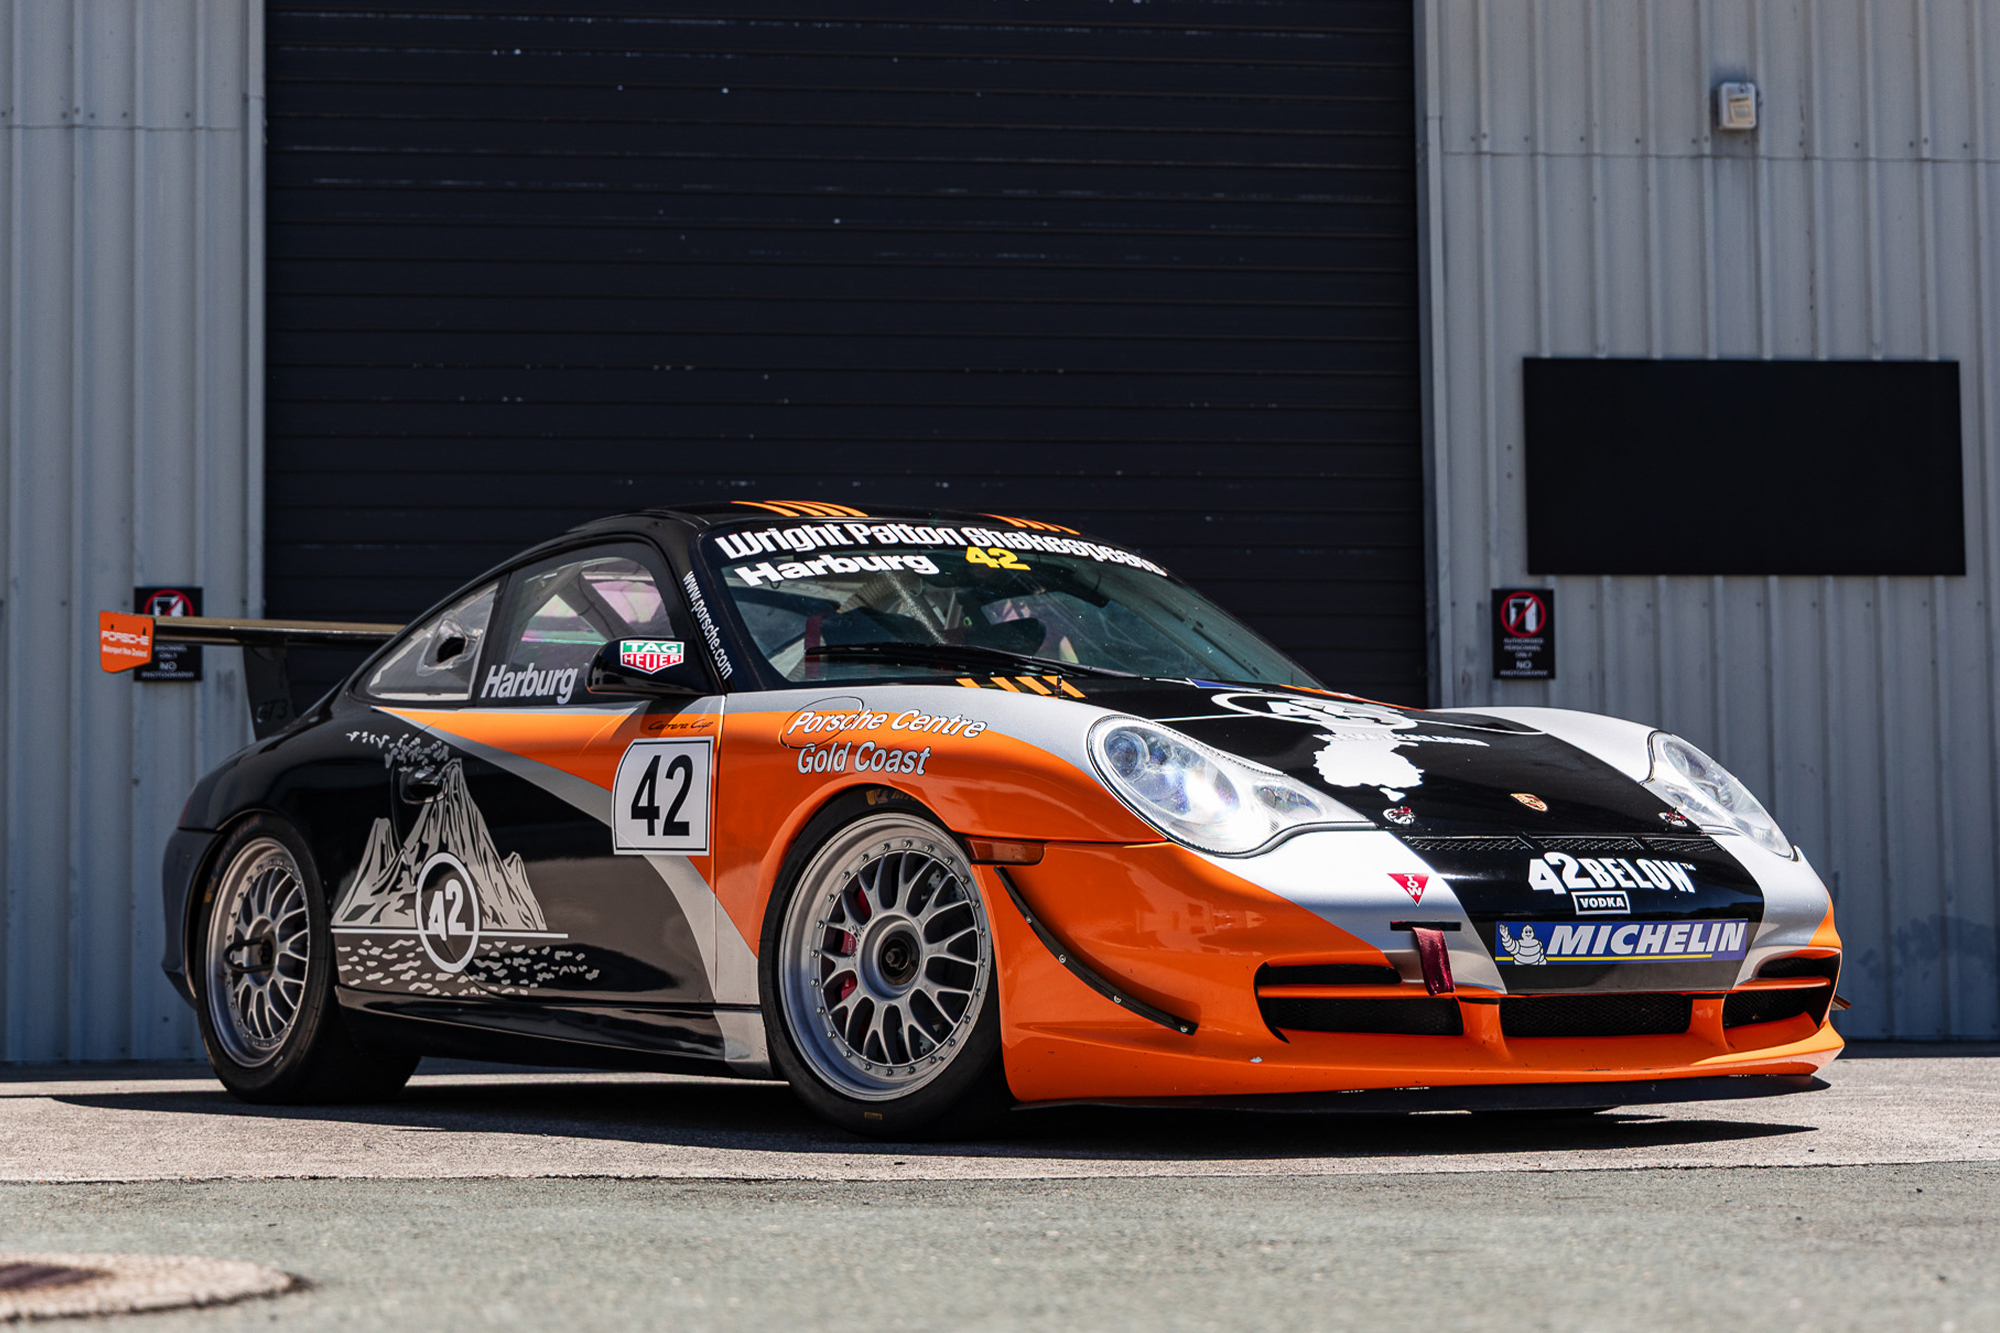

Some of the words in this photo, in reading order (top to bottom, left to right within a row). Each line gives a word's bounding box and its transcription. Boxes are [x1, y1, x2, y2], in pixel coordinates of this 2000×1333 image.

[714, 523, 854, 560] Wright
[843, 523, 969, 546] Patton
[960, 526, 1168, 577] Shakespeare
[965, 546, 1031, 571] 42
[734, 554, 940, 587] Harburg
[101, 630, 150, 646] PORSCHE
[682, 569, 734, 680] www.porsche.com
[625, 641, 679, 653] TAG
[159, 661, 177, 671] NO
[623, 654, 683, 672] HEUER
[1515, 660, 1532, 669] NO
[480, 662, 579, 704] Harburg
[648, 720, 689, 730] Carrera
[690, 718, 714, 733] Cup
[787, 708, 875, 737] Porsche
[891, 708, 988, 739] Centre
[796, 740, 853, 775] Gold
[853, 740, 932, 776] Coast
[630, 753, 694, 838] 42
[1403, 873, 1422, 896] TOW
[428, 878, 467, 941] 42
[1579, 897, 1625, 909] VODKA
[1546, 922, 1746, 955] MICHELIN
